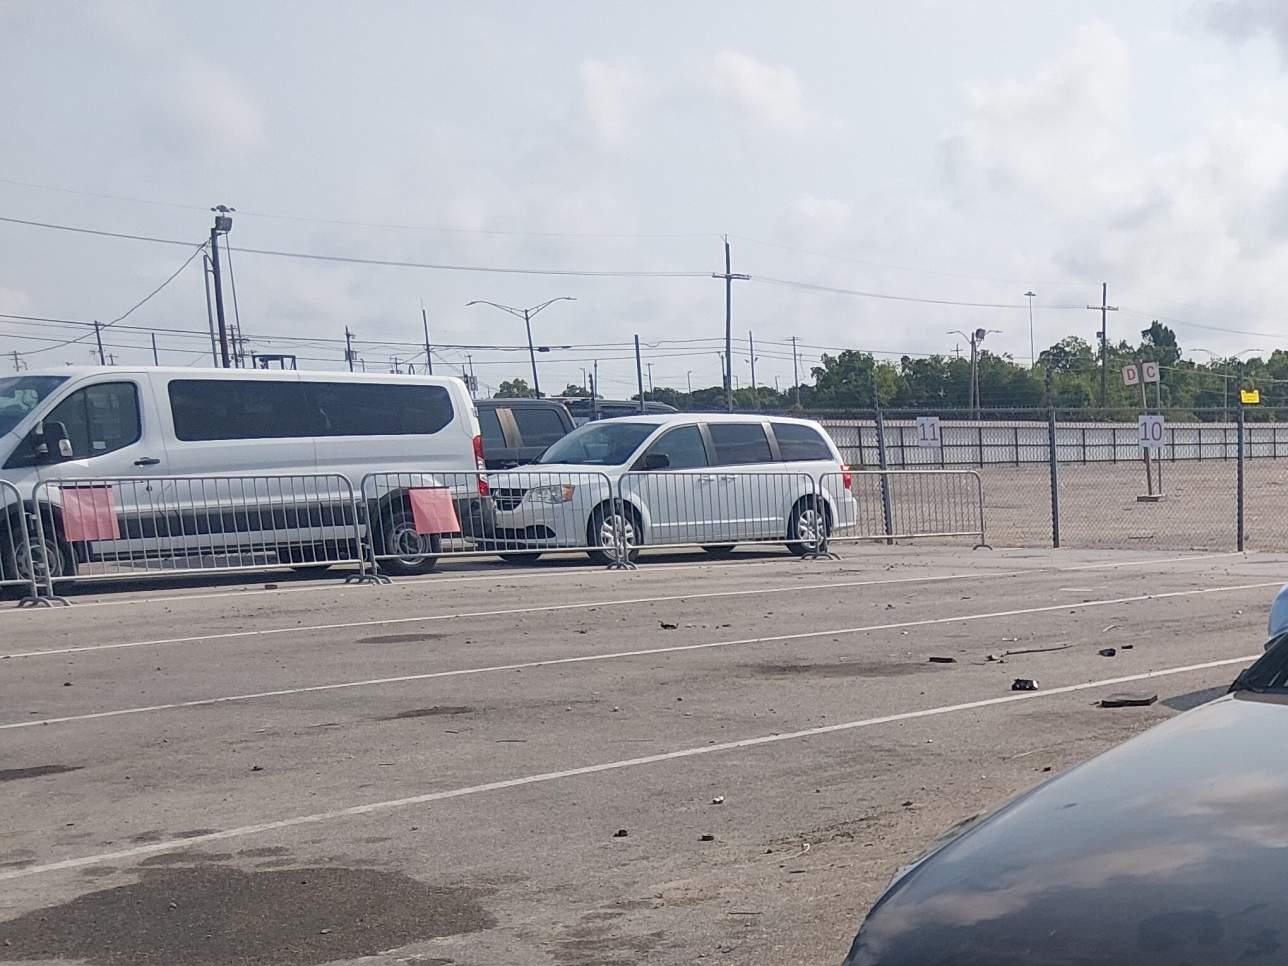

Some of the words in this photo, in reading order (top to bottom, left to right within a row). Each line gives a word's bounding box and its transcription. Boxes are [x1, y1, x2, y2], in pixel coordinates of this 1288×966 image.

[1126, 368, 1136, 380] D
[1146, 366, 1156, 378] C
[920, 423, 939, 441] 11
[1140, 421, 1162, 441] 10
